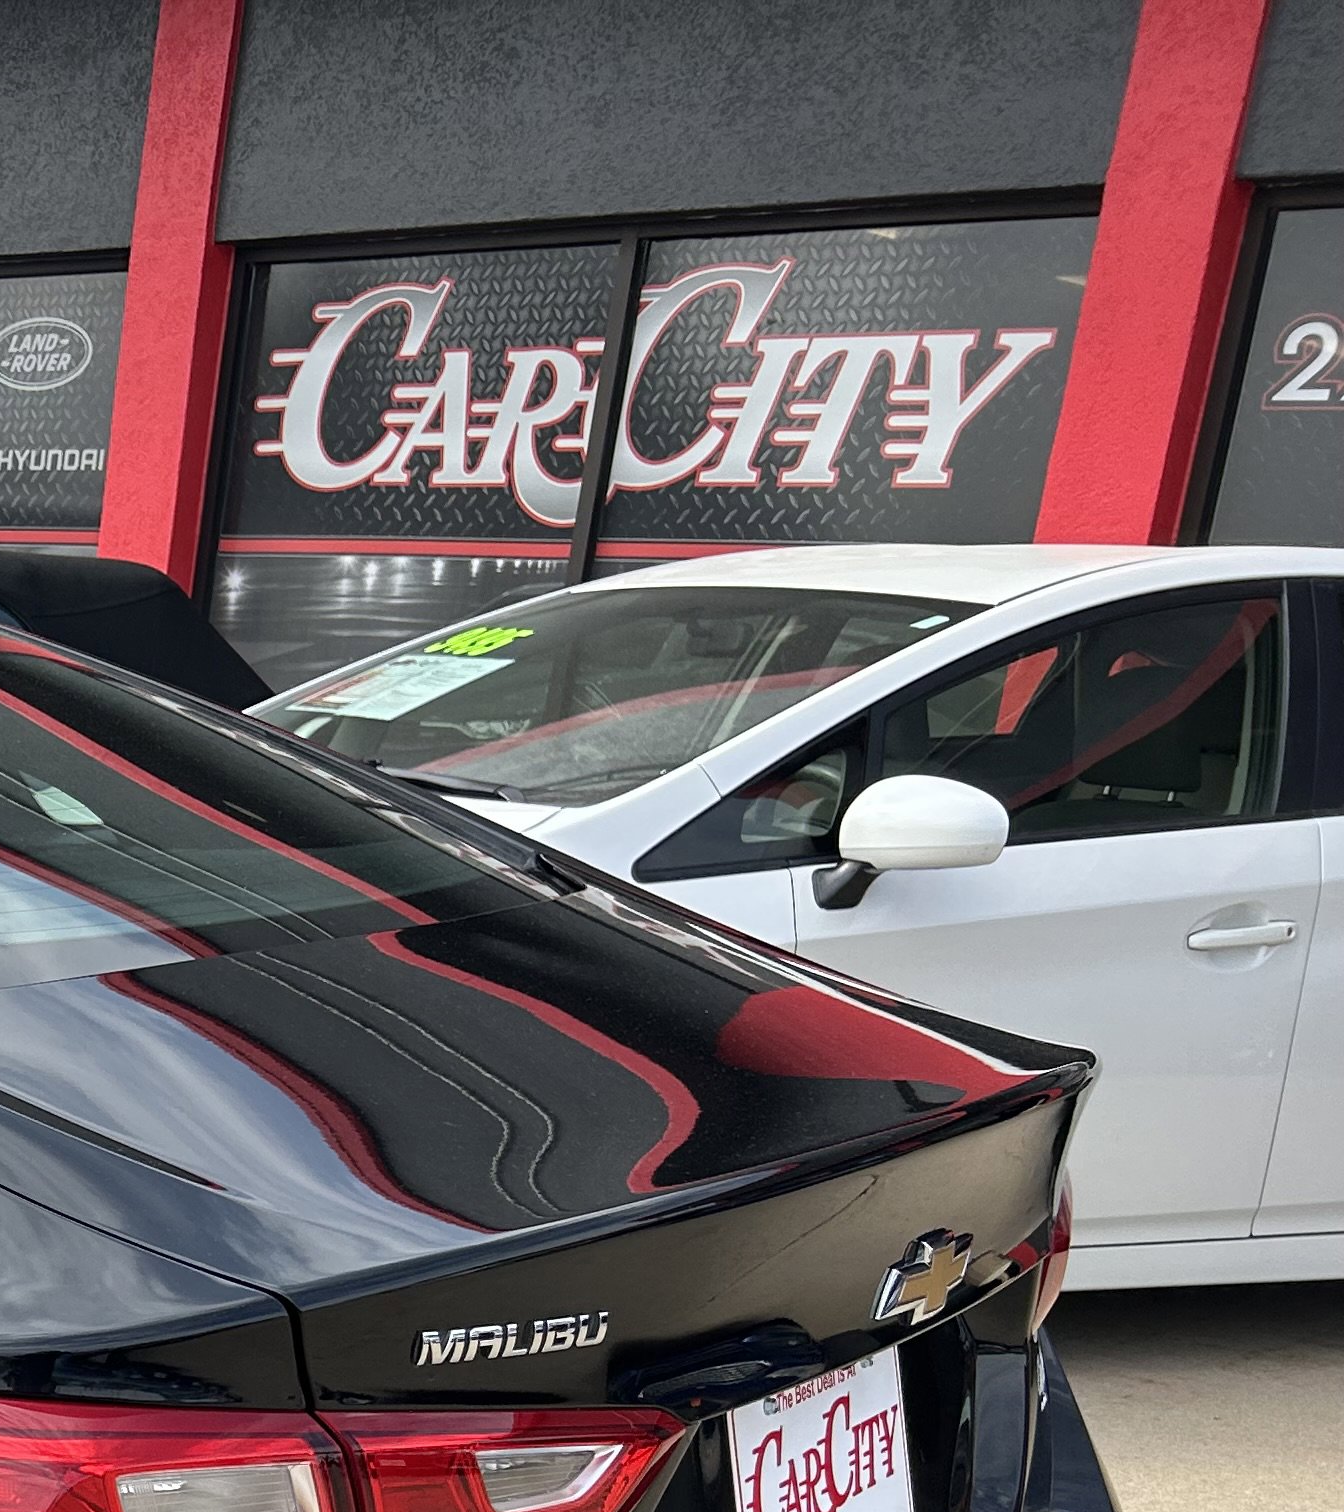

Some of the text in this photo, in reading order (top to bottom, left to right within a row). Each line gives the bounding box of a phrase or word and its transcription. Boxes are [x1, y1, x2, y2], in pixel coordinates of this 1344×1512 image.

[8, 333, 60, 353] LAND
[10, 352, 72, 373] ROVER
[1265, 315, 1344, 408] 2
[415, 1310, 610, 1367] MALIBU
[776, 1390, 794, 1413] The
[795, 1382, 816, 1405] Best
[817, 1371, 836, 1394] Deal
